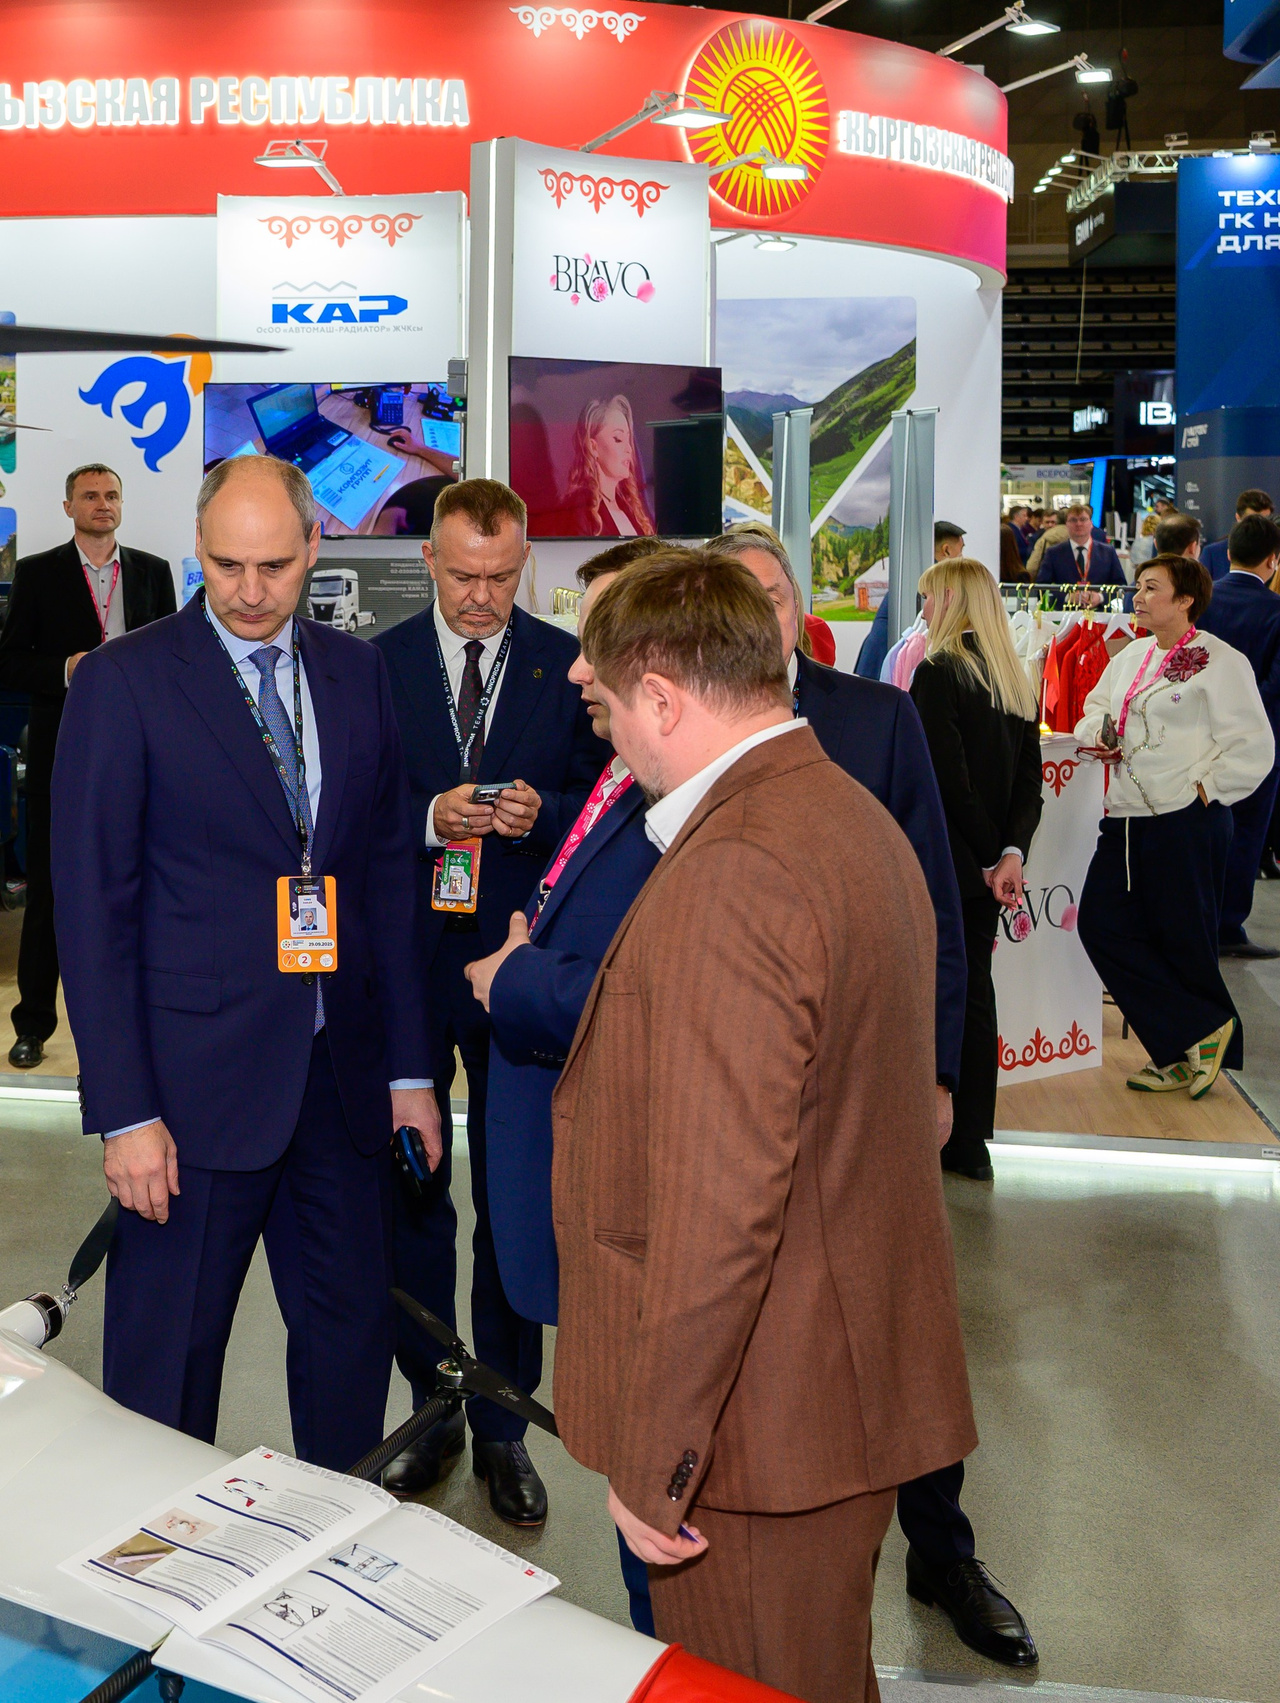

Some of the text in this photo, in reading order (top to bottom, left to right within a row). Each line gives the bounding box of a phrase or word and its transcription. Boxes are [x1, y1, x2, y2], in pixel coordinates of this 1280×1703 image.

[190, 76, 470, 126] РЕСПУБЛИКА
[844, 110, 977, 177] КЫРГЫЗСКАЯ
[1217, 189, 1280, 207] ТЕХ
[1219, 212, 1255, 229] ГК
[1216, 234, 1280, 254] ДЛЯ
[553, 254, 650, 302] BRAVO
[272, 295, 408, 324] КАР
[256, 326, 281, 334] ОсОО
[283, 325, 390, 334] «АВТОМАШ-РАДИАТОР»
[1140, 401, 1176, 425] IB
[486, 639, 508, 694] INNOPROM TEAM
[449, 708, 462, 743] INNOPROM
[464, 709, 484, 767] INNOPROM TEAM
[301, 955, 308, 964] 2
